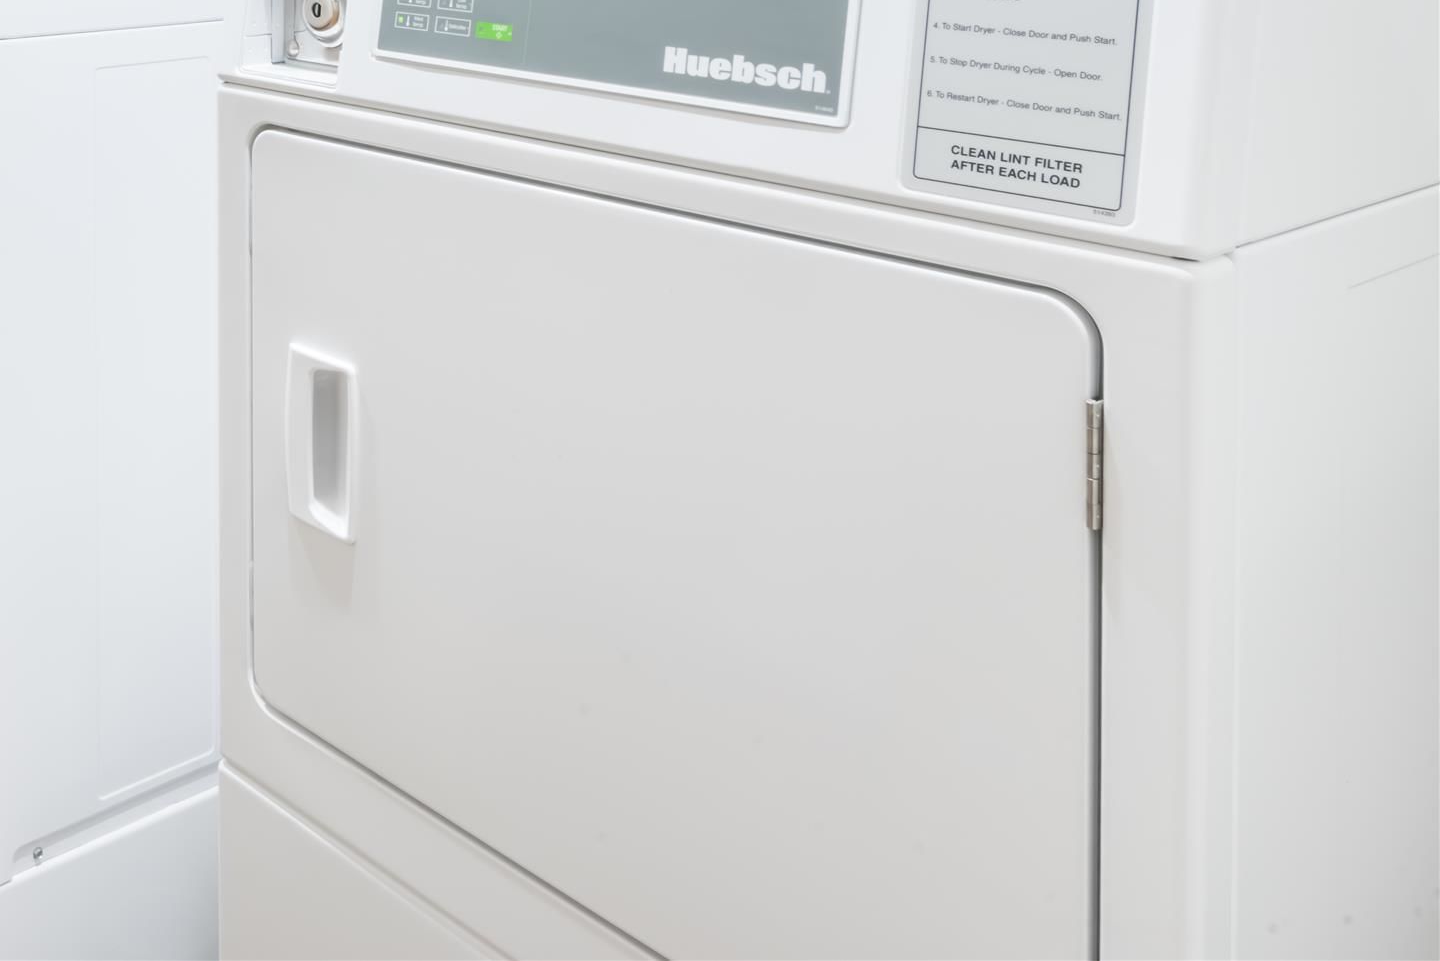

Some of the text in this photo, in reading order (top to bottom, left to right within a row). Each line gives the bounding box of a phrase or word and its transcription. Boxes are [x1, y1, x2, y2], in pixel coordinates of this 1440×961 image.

[942, 22, 951, 31] To
[953, 23, 972, 32] Start
[973, 25, 996, 35] Dryer
[1002, 27, 1026, 37] Close
[1028, 30, 1049, 39] Door
[1051, 32, 1068, 41] and
[1069, 33, 1092, 43] Push
[1094, 35, 1118, 45] Start.
[663, 46, 827, 93] Huebsch
[939, 57, 948, 65] To
[949, 57, 968, 68] Stop
[969, 59, 992, 70] Dryer
[993, 62, 1021, 74] During
[1022, 65, 1046, 75] Cycle
[1054, 68, 1077, 78] Open
[1079, 71, 1103, 81] Door.
[936, 91, 945, 99] To
[946, 92, 976, 102] Restart
[977, 95, 999, 106] Dryer
[1006, 99, 1031, 110] Close
[1032, 102, 1053, 112] Door
[1055, 105, 1072, 115] and
[1073, 107, 1096, 118] Push
[1098, 110, 1122, 121] Start.
[951, 145, 1083, 174] CLEAN LINT FILTER
[950, 160, 1081, 188] AFTER EACH LOAD
